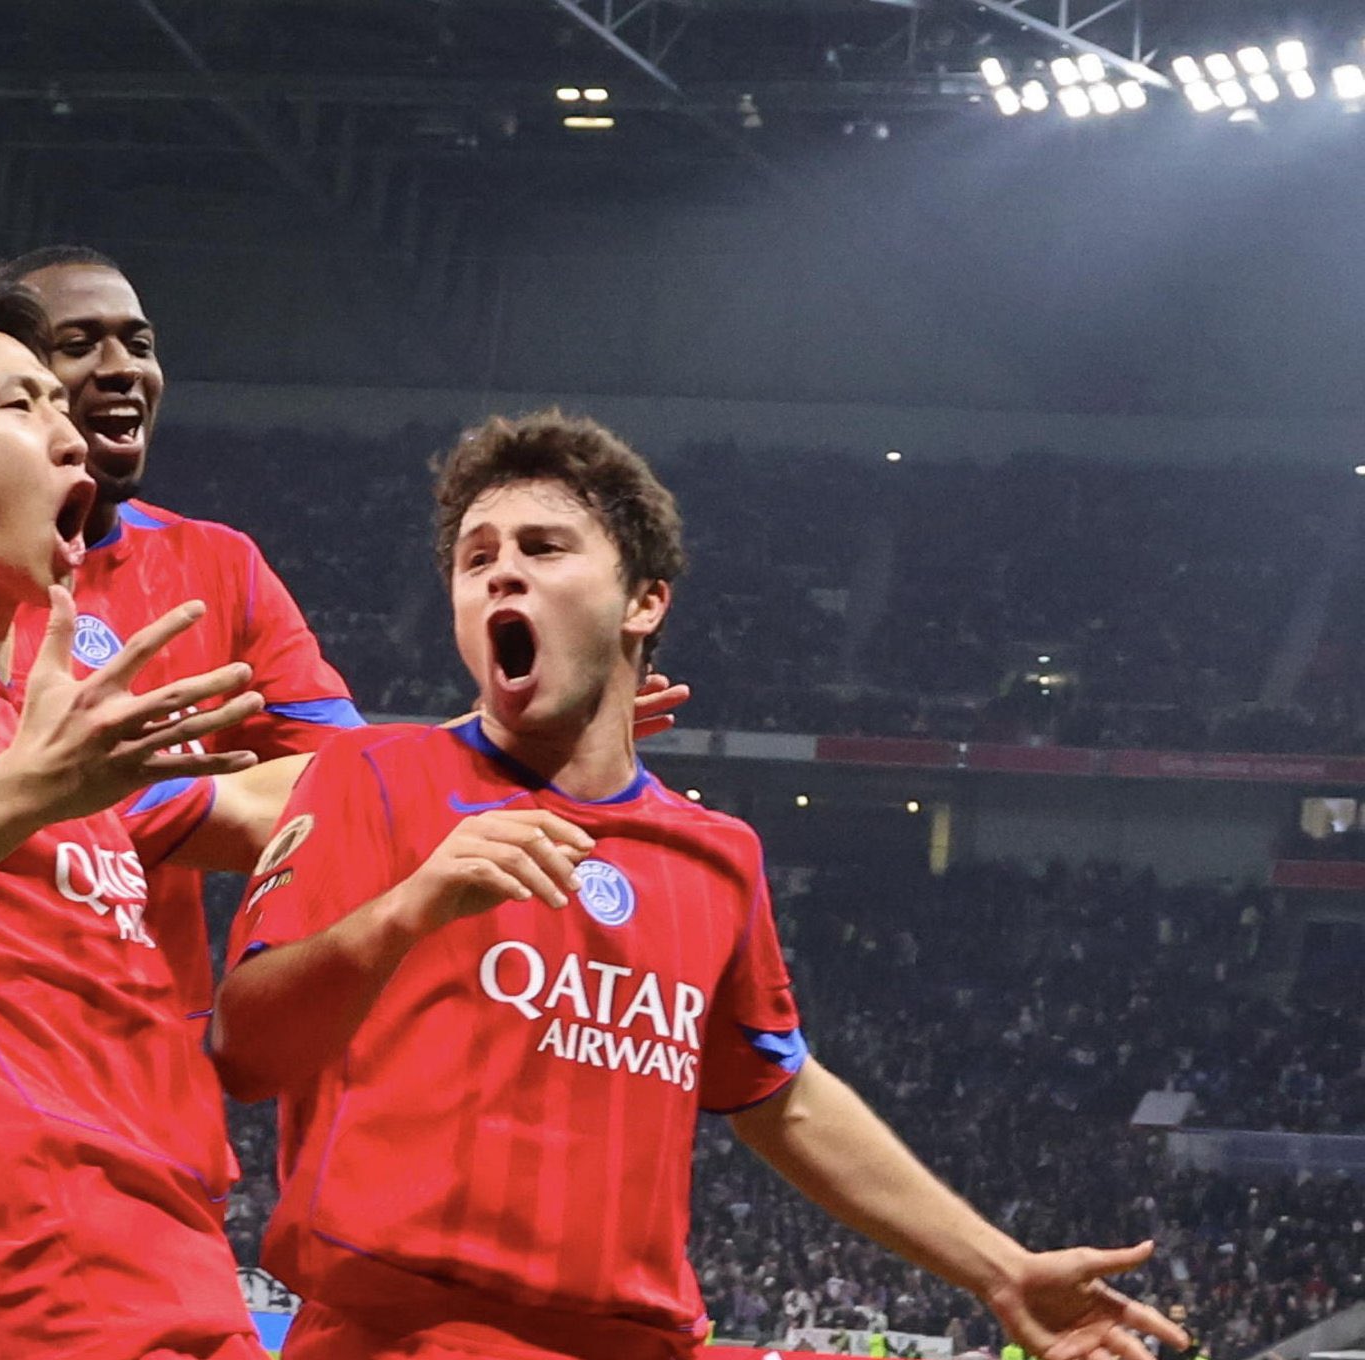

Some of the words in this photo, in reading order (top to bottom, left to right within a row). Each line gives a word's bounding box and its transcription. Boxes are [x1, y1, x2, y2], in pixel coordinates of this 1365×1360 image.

[55, 841, 149, 916] QATA
[479, 940, 706, 1050] QATAR
[536, 1018, 699, 1092] AIRWAYS
